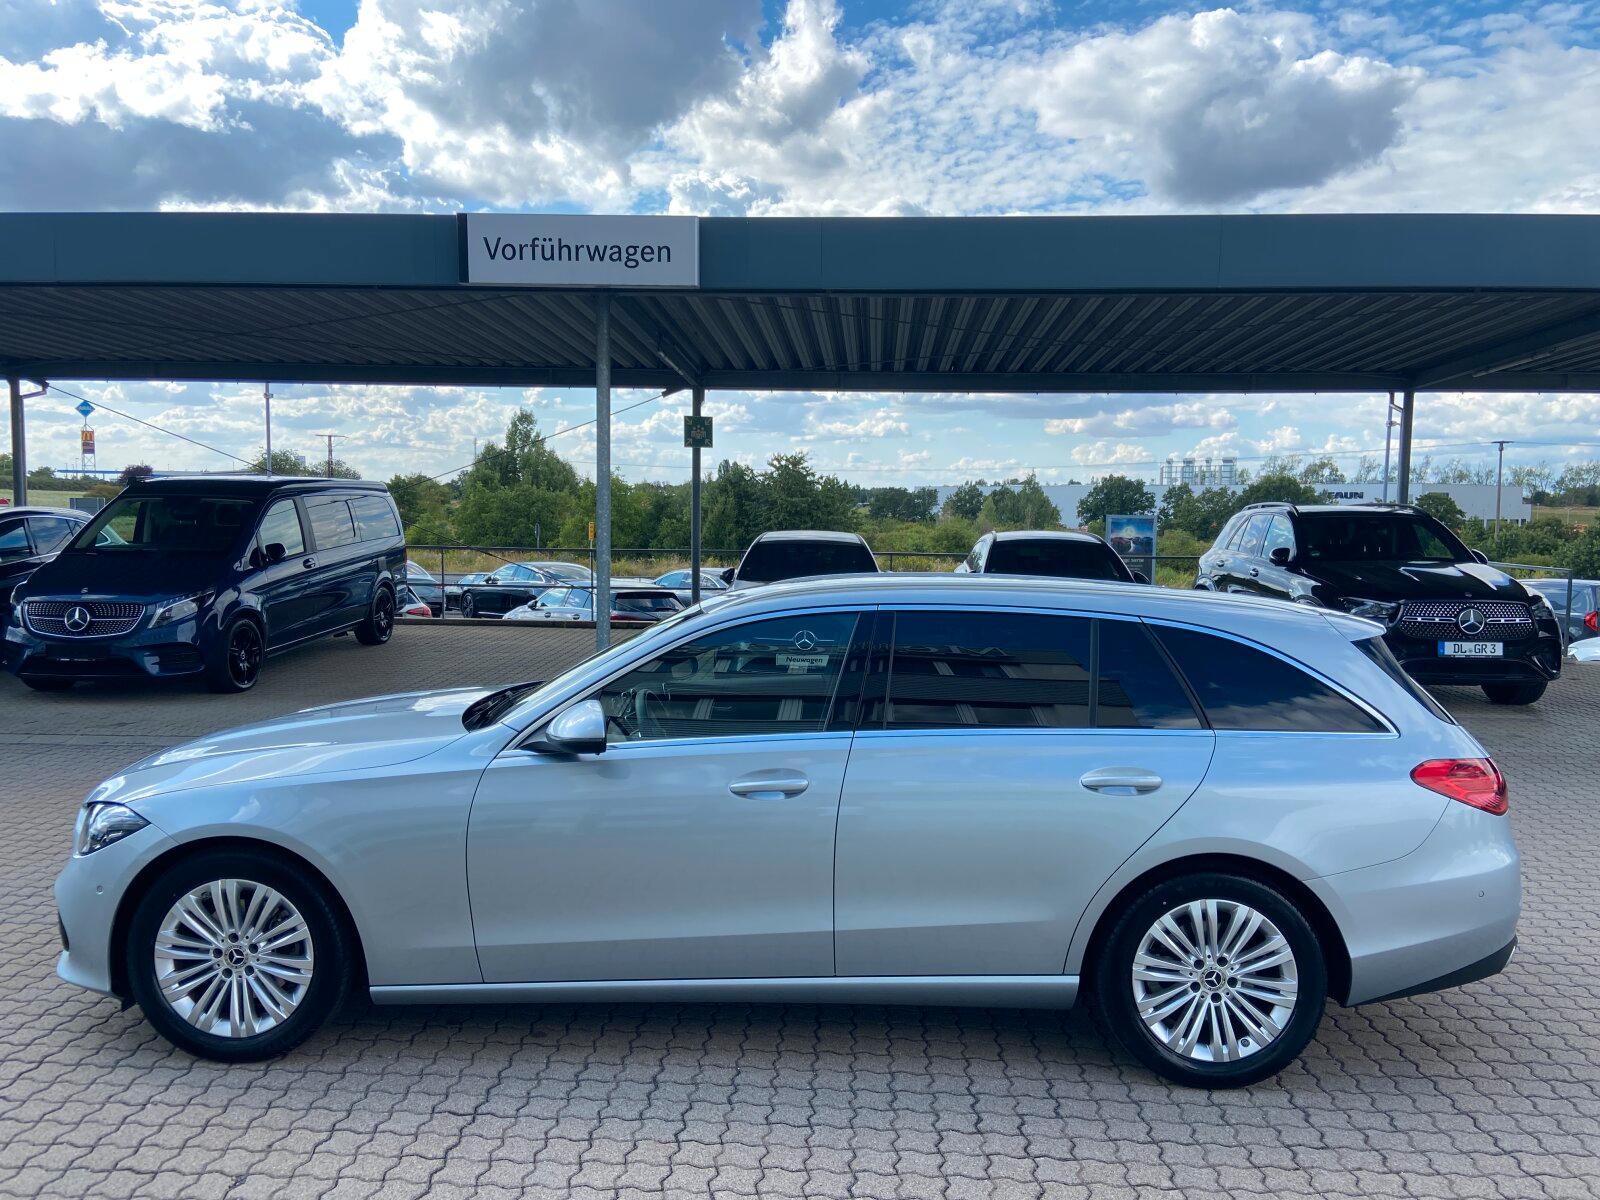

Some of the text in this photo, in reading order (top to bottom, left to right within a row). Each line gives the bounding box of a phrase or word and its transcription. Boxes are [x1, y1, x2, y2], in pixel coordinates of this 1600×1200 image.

[483, 236, 672, 269] Vorführwagen
[1453, 643, 1497, 654] DL GR 3
[785, 655, 824, 664] Neuwagen
